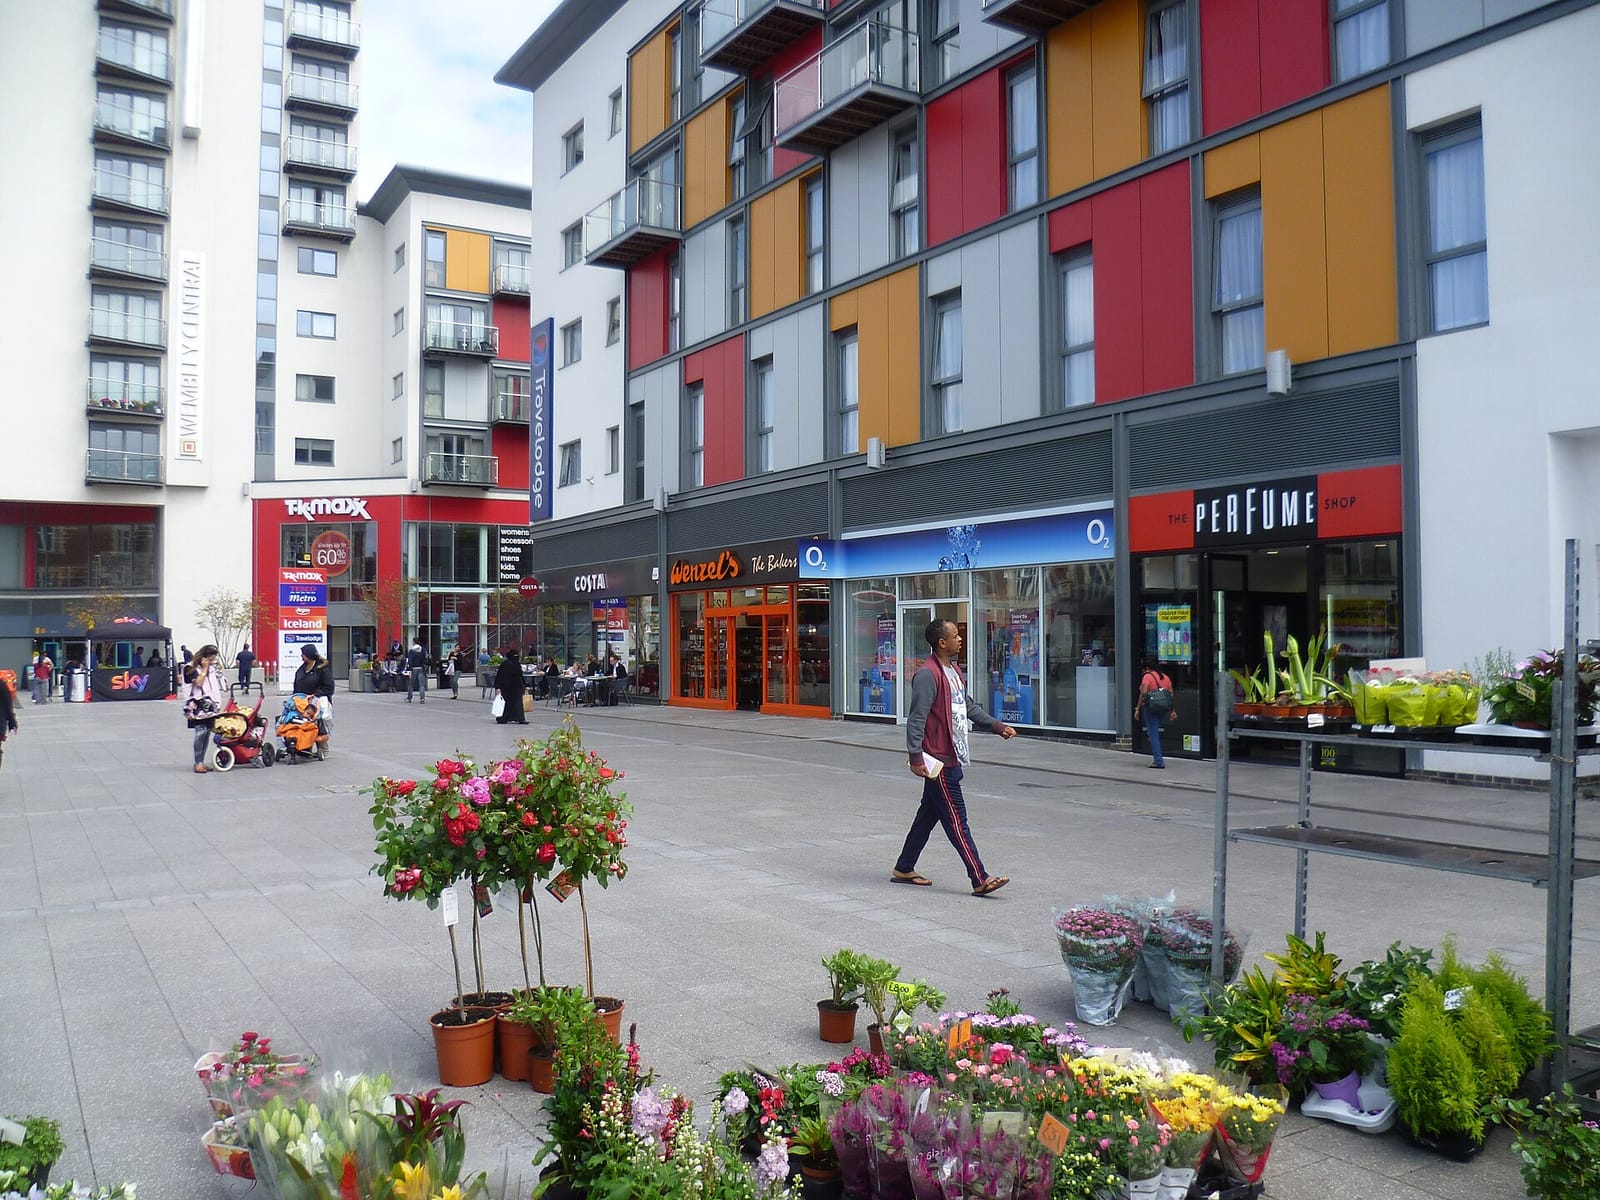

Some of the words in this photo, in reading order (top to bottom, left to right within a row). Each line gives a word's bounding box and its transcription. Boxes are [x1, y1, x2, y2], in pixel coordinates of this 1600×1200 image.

[532, 369, 546, 509] Travelodge
[1168, 514, 1187, 524] THE
[1196, 488, 1315, 535] PERFUME
[1324, 497, 1357, 510] SHOP
[317, 549, 347, 565] 60%
[670, 551, 739, 584] Wenzel's
[751, 555, 765, 573] The
[766, 553, 798, 573] Bakers
[574, 573, 606, 592] COSTA
[289, 594, 317, 602] Metro
[284, 619, 322, 629] Iceland
[111, 671, 150, 692] sky
[997, 712, 1024, 721] PRIORITY
